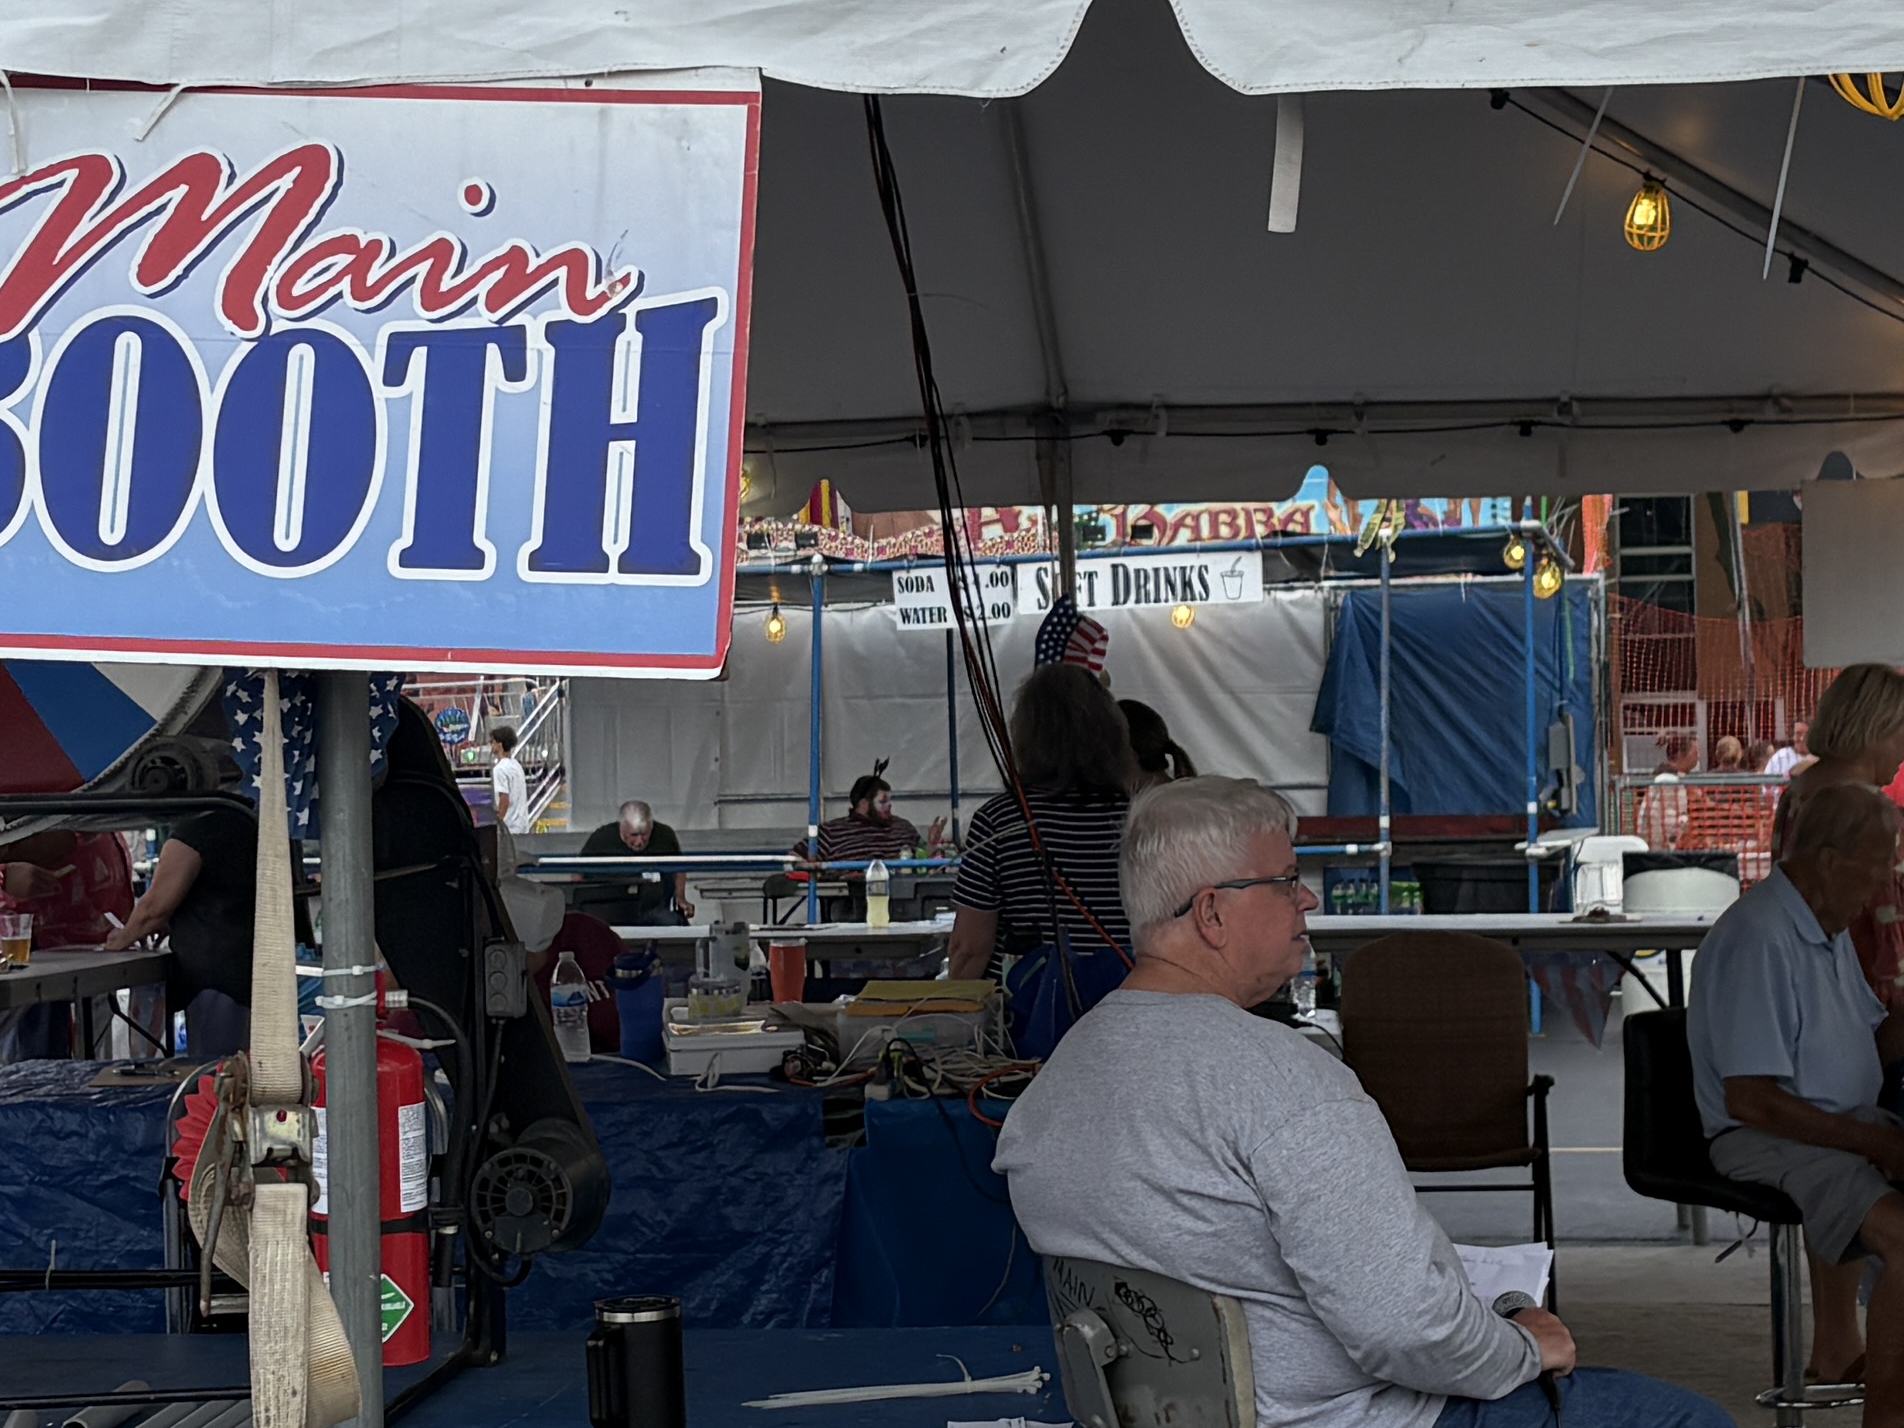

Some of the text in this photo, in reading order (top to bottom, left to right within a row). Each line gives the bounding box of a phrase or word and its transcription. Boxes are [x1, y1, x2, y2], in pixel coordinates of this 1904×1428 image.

[897, 575, 935, 594] SODA
[1111, 563, 1211, 606] DRINKS
[899, 606, 947, 625] WATER
